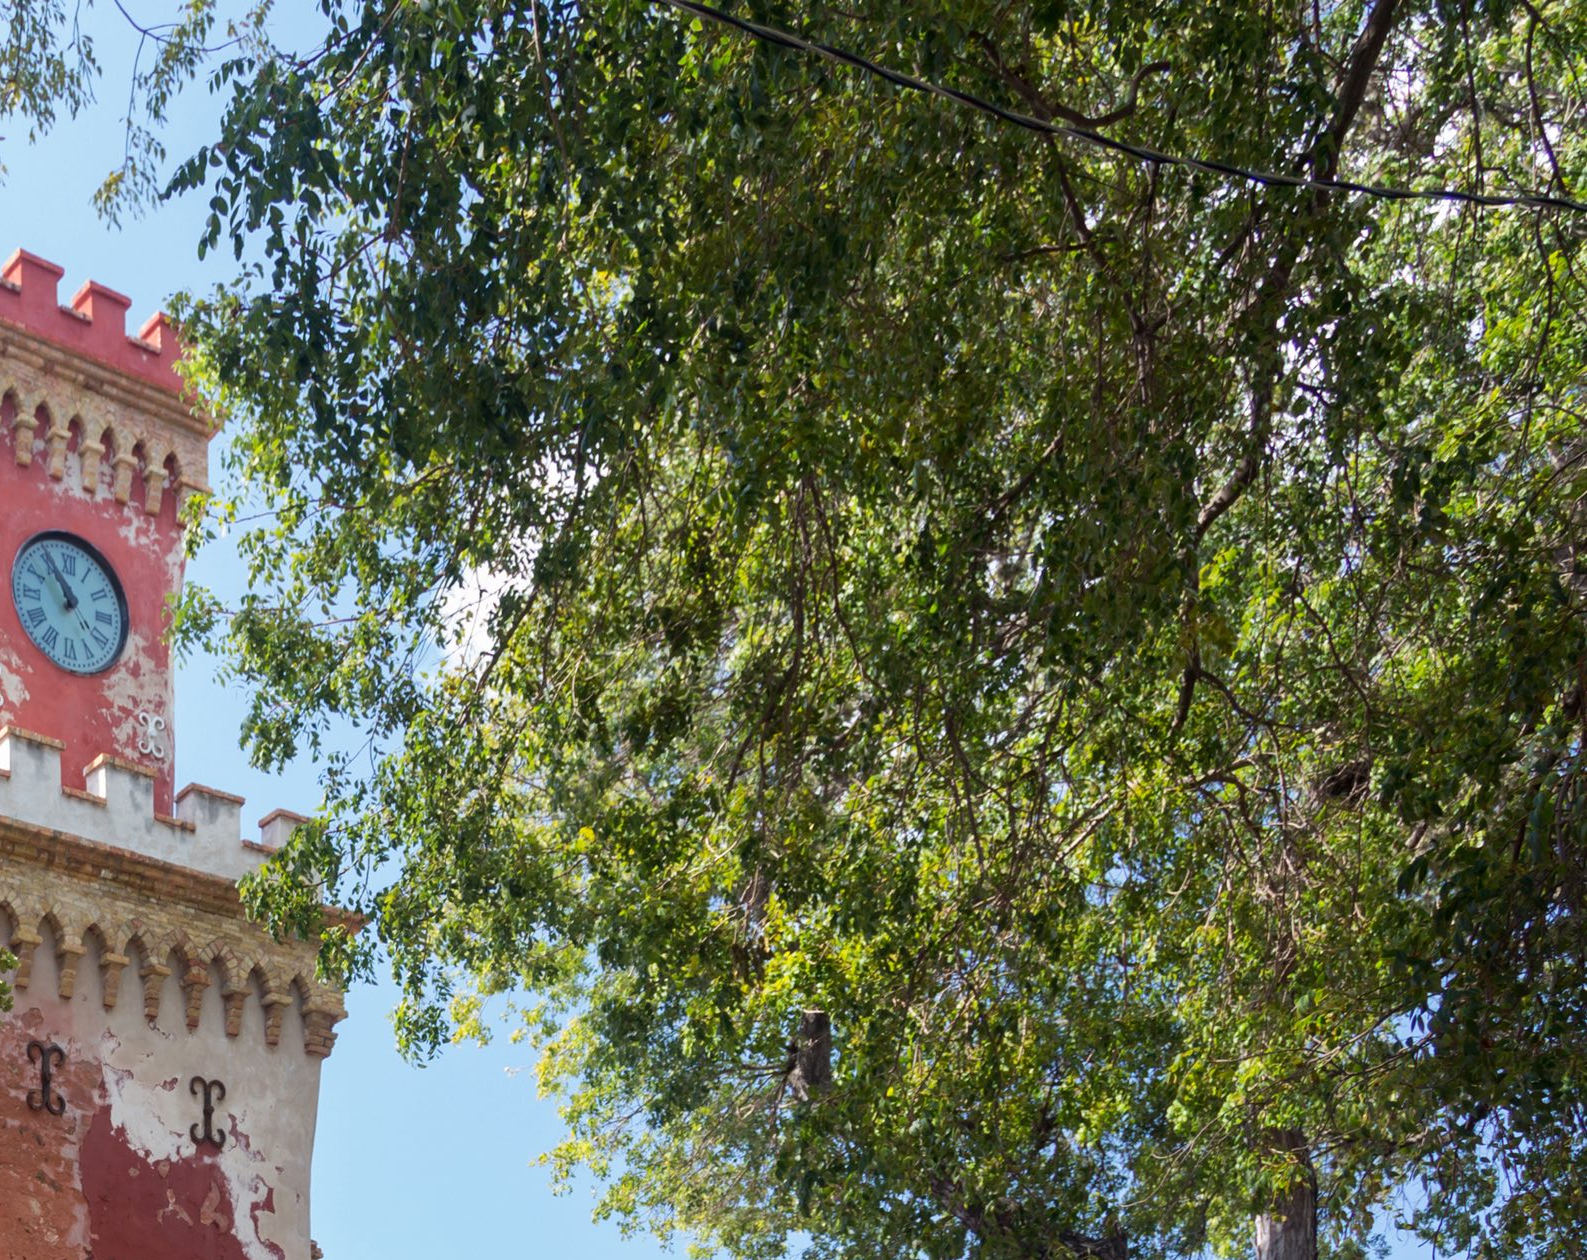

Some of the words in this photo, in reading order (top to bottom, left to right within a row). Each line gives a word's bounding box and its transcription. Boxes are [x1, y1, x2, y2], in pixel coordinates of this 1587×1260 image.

[27, 563, 45, 584] X
[61, 552, 76, 576] XII
[80, 567, 91, 584] I
[22, 583, 41, 601] IX
[90, 588, 108, 602] II
[27, 606, 47, 628] VIII
[95, 610, 112, 625] III
[41, 625, 59, 650] VII
[64, 637, 77, 660] VI
[81, 638, 94, 659] V
